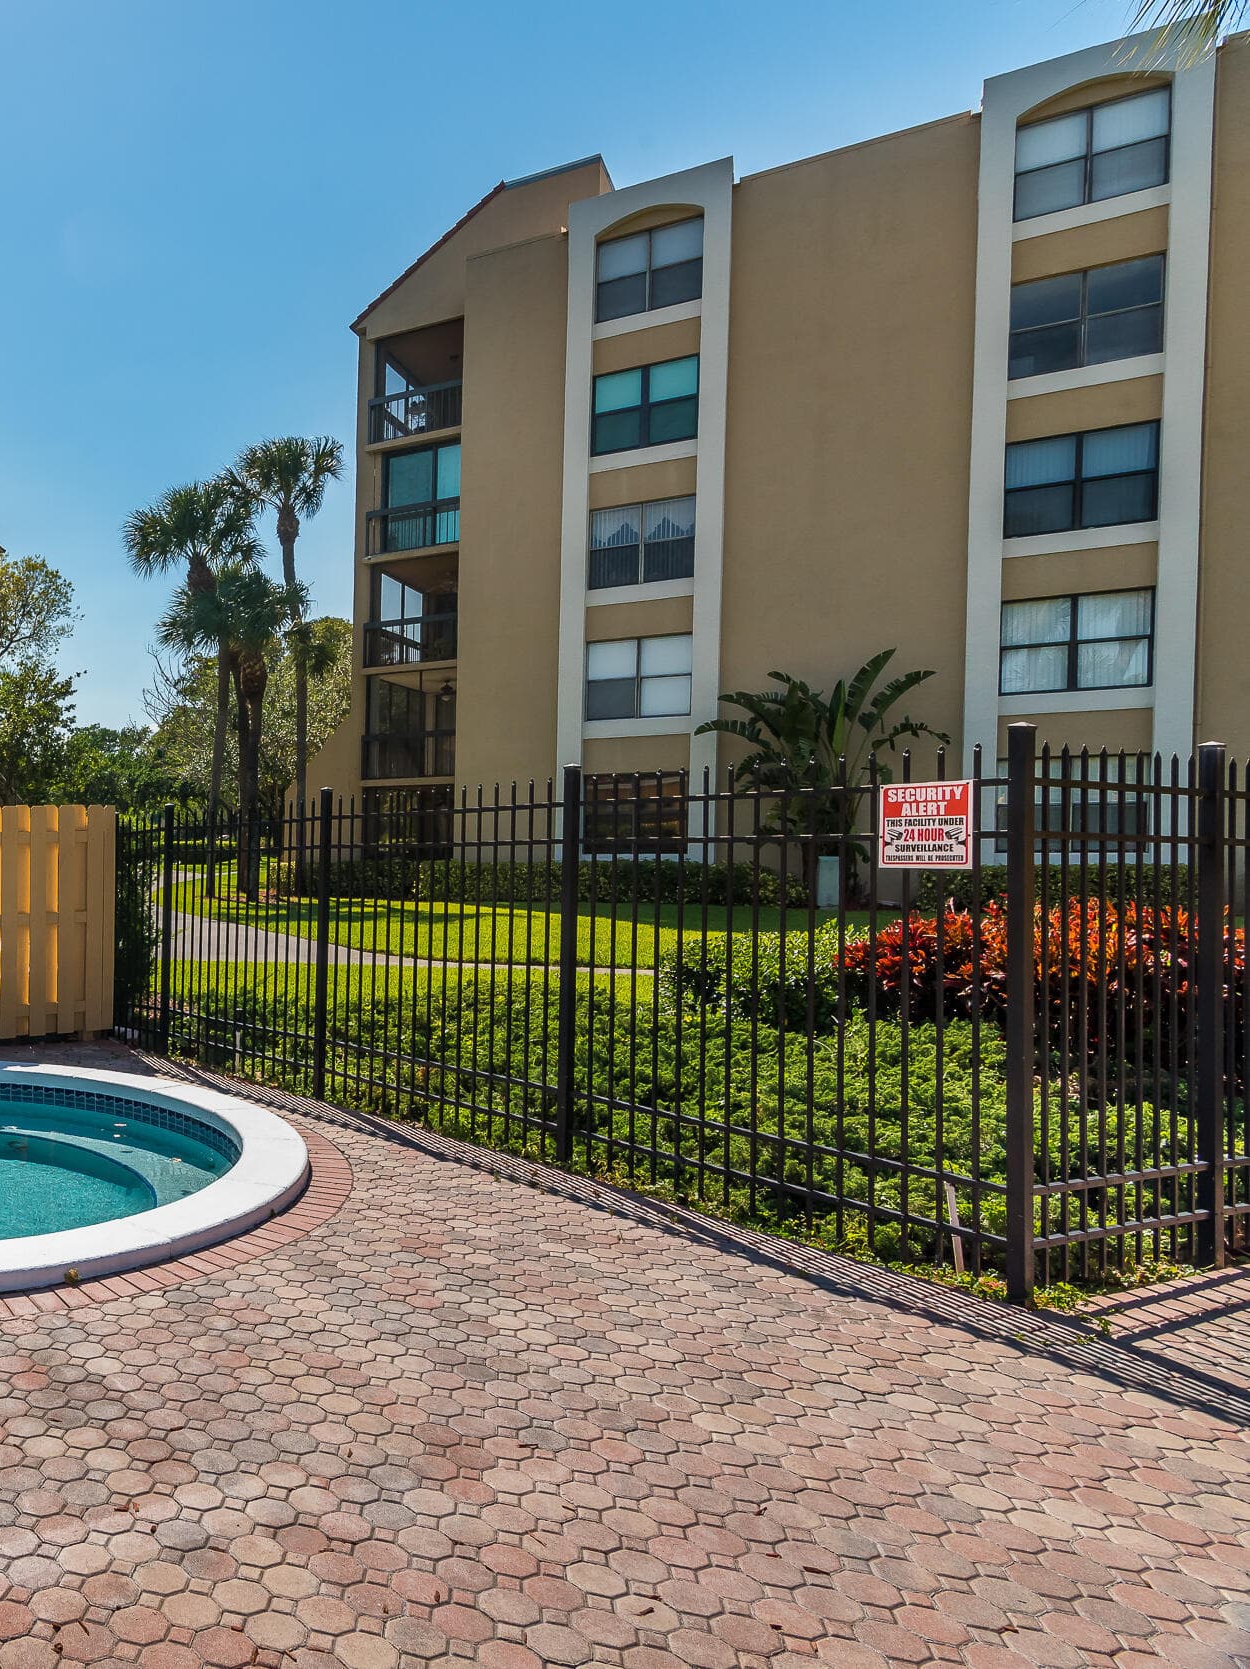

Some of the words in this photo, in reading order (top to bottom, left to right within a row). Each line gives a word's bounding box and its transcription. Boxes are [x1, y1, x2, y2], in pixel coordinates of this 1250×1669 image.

[887, 786, 963, 802] SECURITY
[901, 802, 947, 816] ALERT
[886, 819, 903, 827] THIS
[904, 818, 936, 826] FACILITY
[938, 817, 964, 825] UNDER
[904, 829, 914, 841] 24
[918, 828, 944, 841] HOUR
[895, 843, 954, 852] SURVEILLANCE
